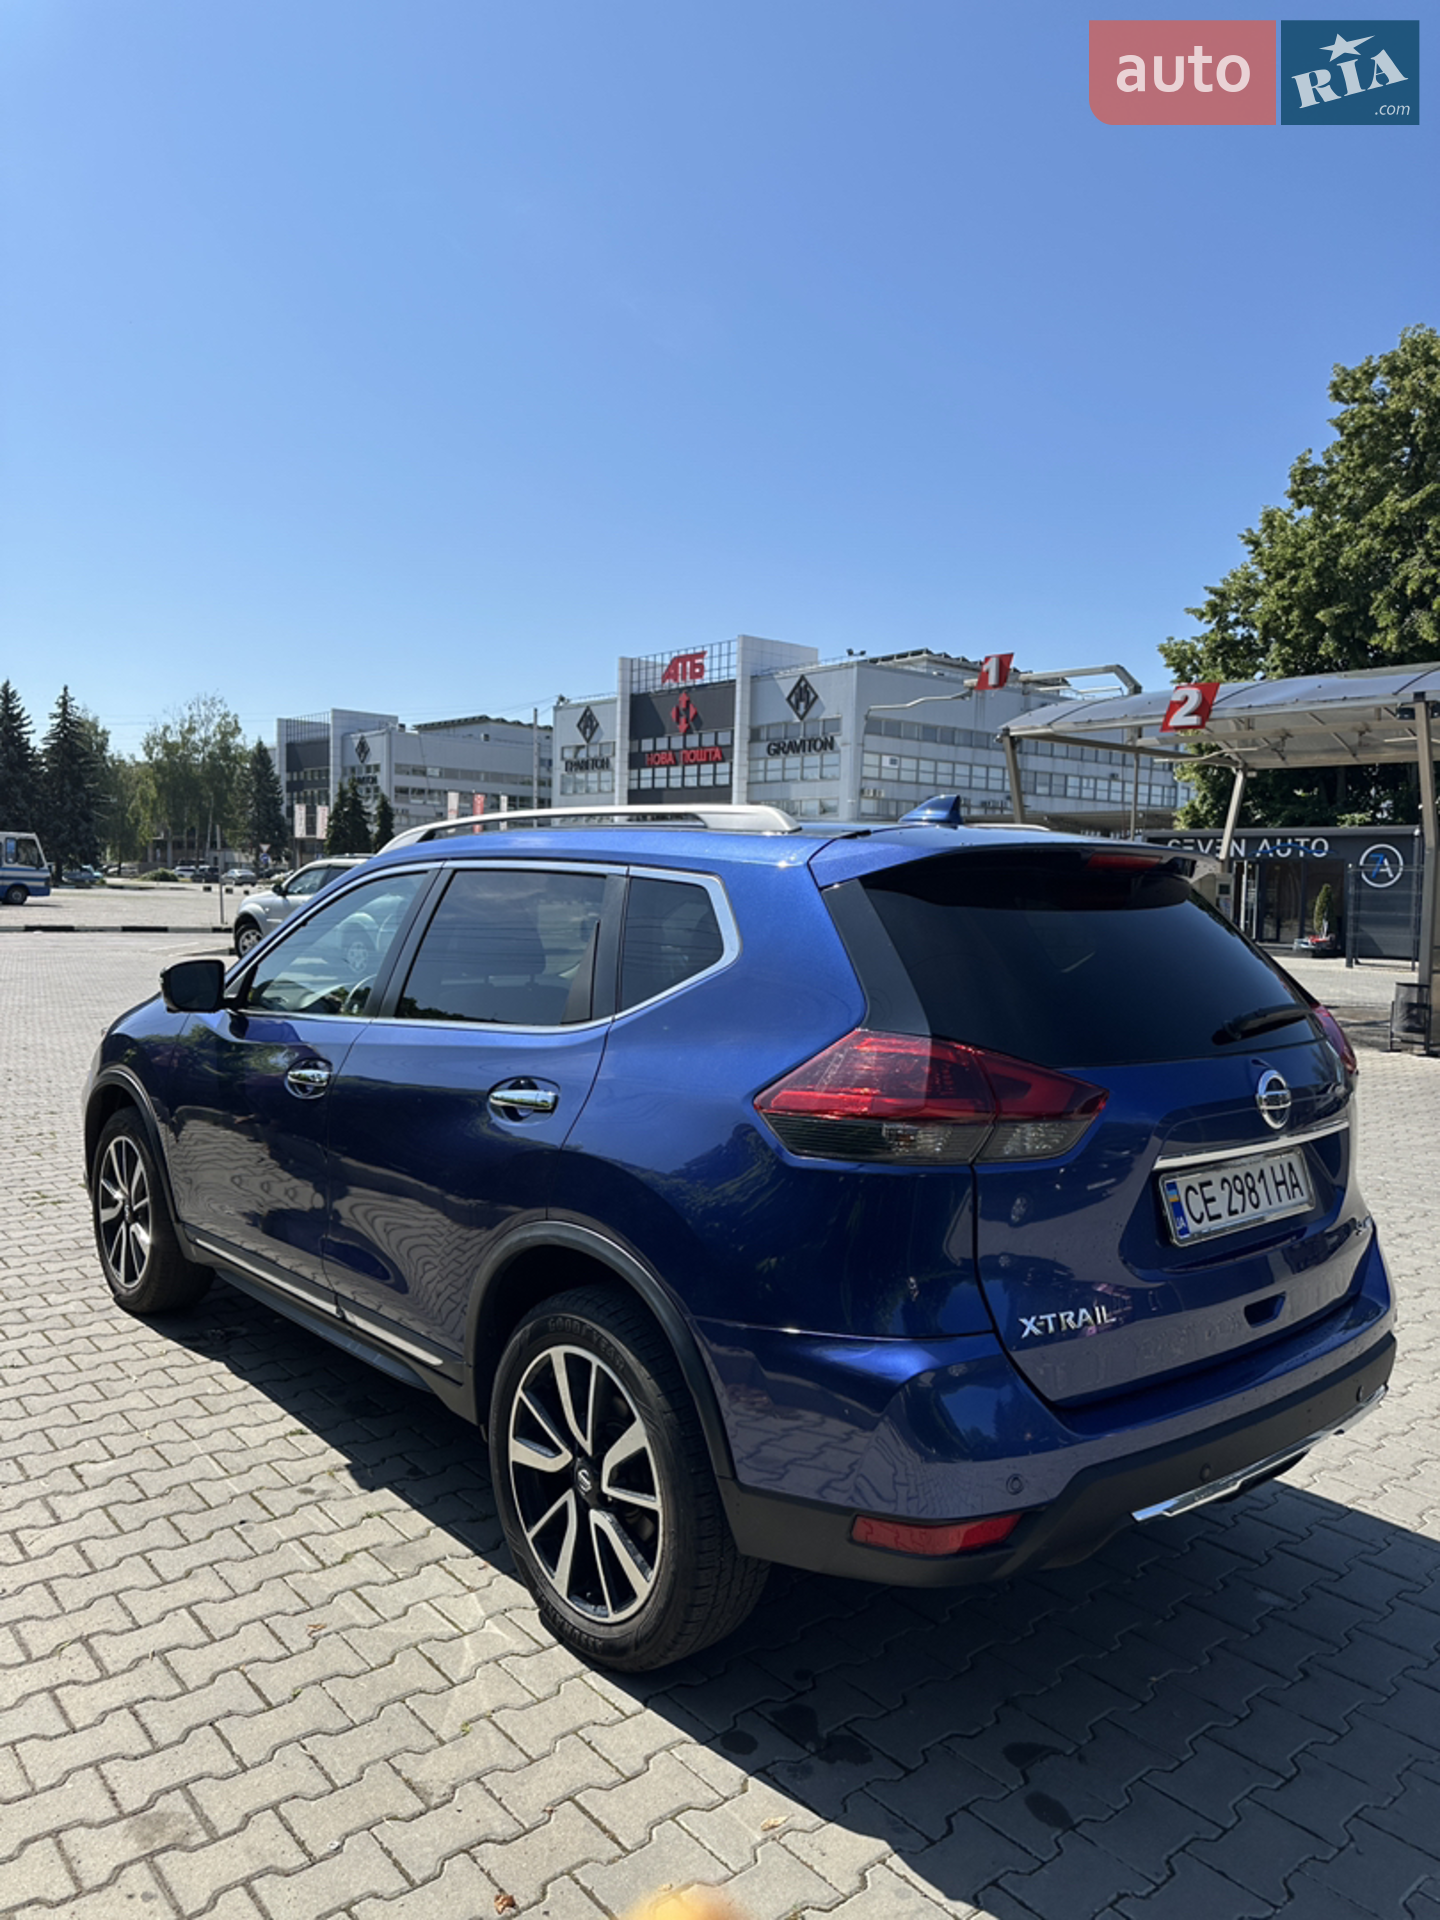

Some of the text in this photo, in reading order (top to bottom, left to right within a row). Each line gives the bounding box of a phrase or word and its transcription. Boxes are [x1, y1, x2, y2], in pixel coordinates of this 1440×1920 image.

[661, 651, 707, 685] АТБ
[983, 657, 1001, 686] 1
[1168, 689, 1203, 727] 2
[645, 746, 722, 767] НОВА ПОШТА
[767, 736, 834, 757] GRAVITON
[1256, 838, 1329, 858] AUTO
[1184, 1162, 1304, 1224] CE 2981 HA
[1018, 1305, 1116, 1339] X-TRAIL
